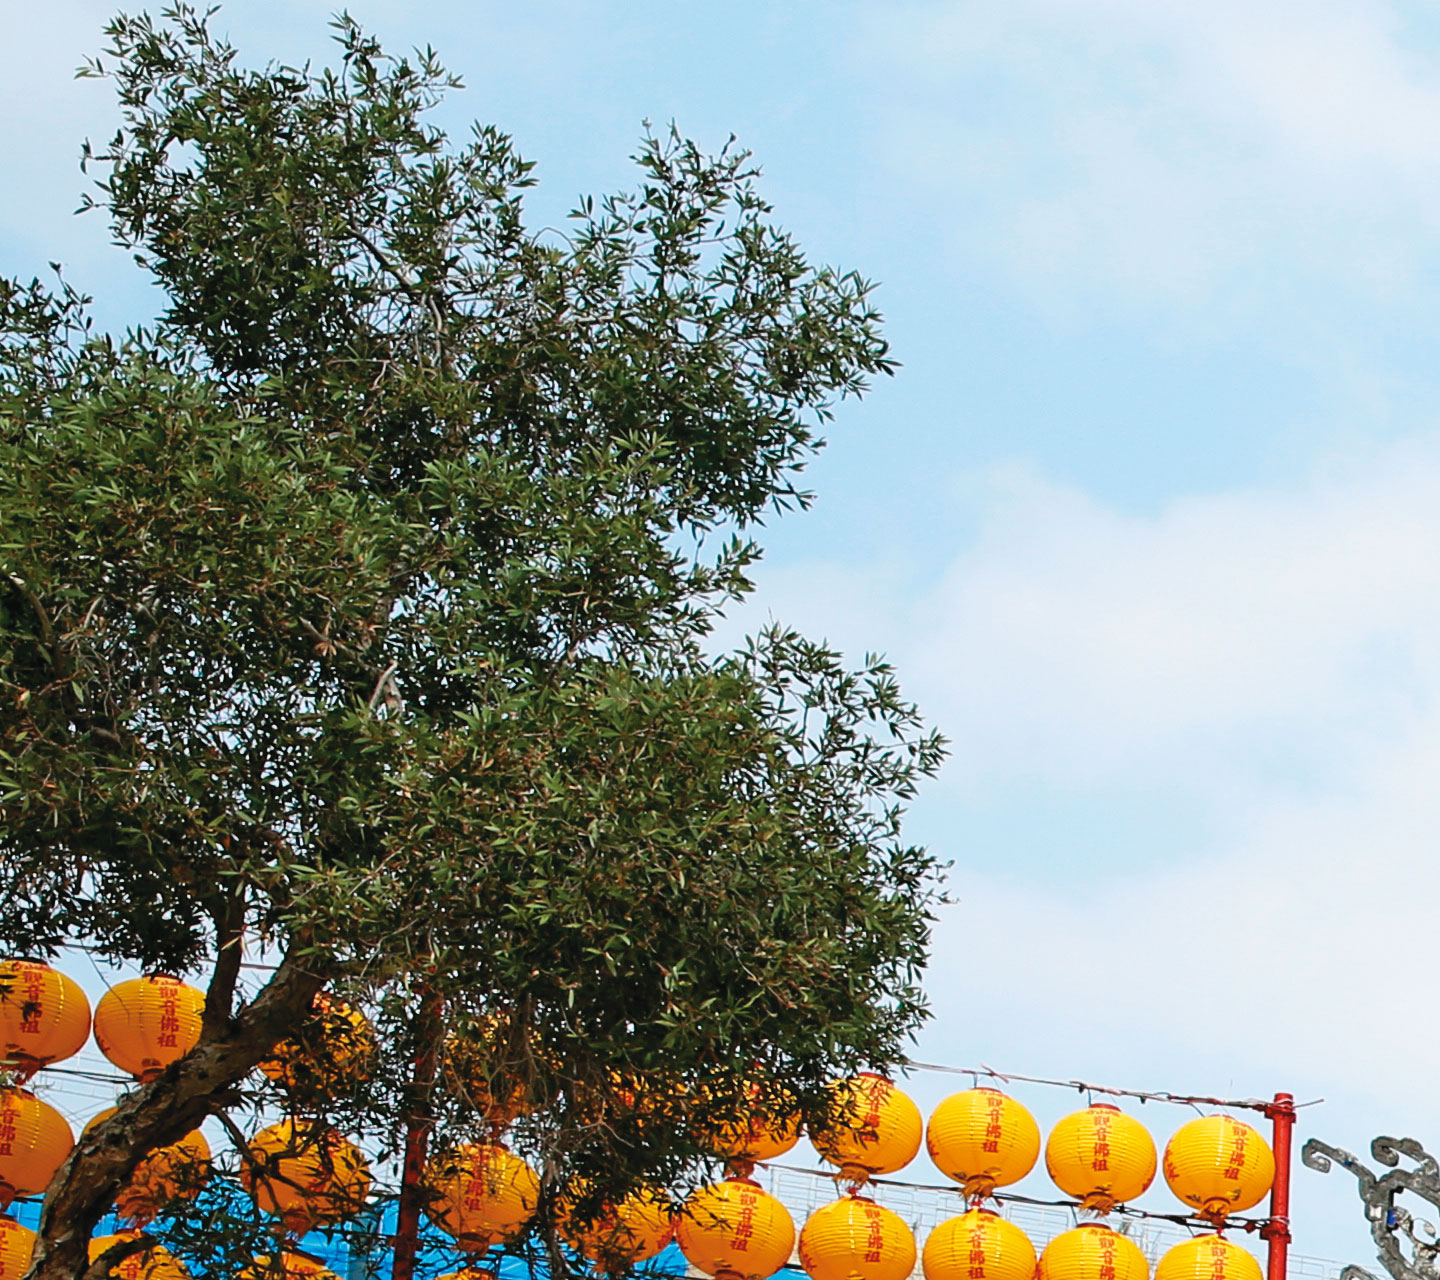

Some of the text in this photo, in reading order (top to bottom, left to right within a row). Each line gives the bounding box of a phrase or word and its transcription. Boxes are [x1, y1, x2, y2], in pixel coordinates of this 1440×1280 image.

[156, 986, 179, 1047] 觀音佛祖
[981, 1098, 1002, 1152] 觀音佛祖
[1091, 1116, 1110, 1170] 觀音佛祖
[1223, 1126, 1247, 1180] 觀音佛祖
[729, 1196, 756, 1250] 觀音佛祖
[863, 1208, 882, 1262] 觀音佛祖
